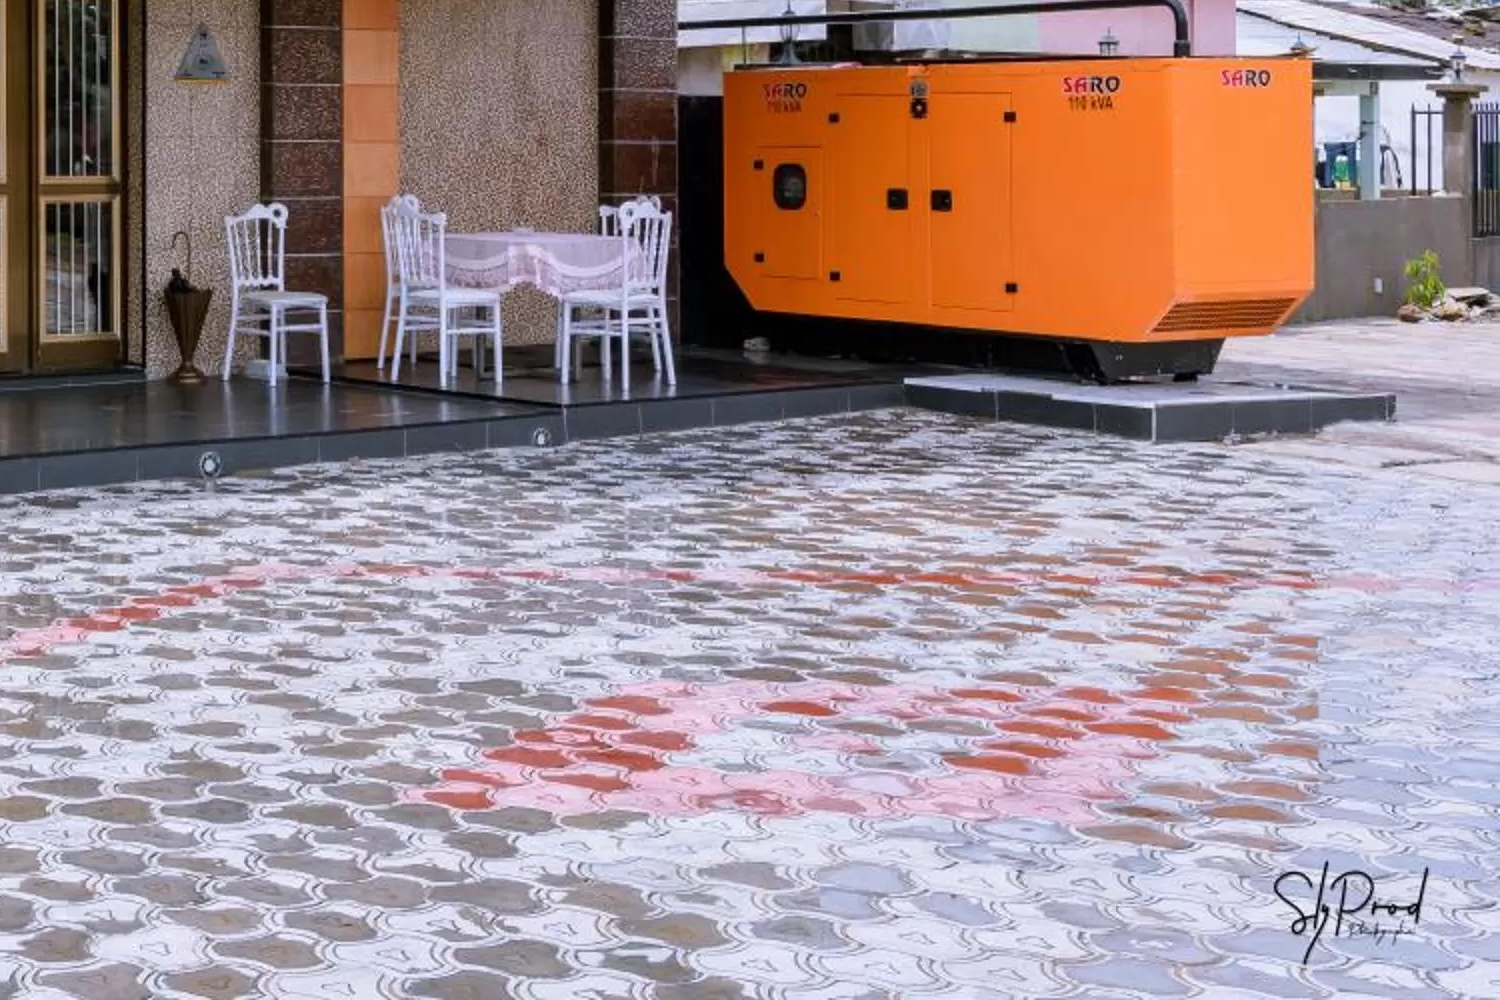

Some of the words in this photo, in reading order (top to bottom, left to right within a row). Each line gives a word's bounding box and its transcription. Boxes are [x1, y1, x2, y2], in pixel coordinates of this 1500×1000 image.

[1063, 75, 1120, 94] SARO
[1221, 69, 1271, 87] SARO
[763, 82, 807, 98] SARO
[1068, 96, 1087, 112] 110
